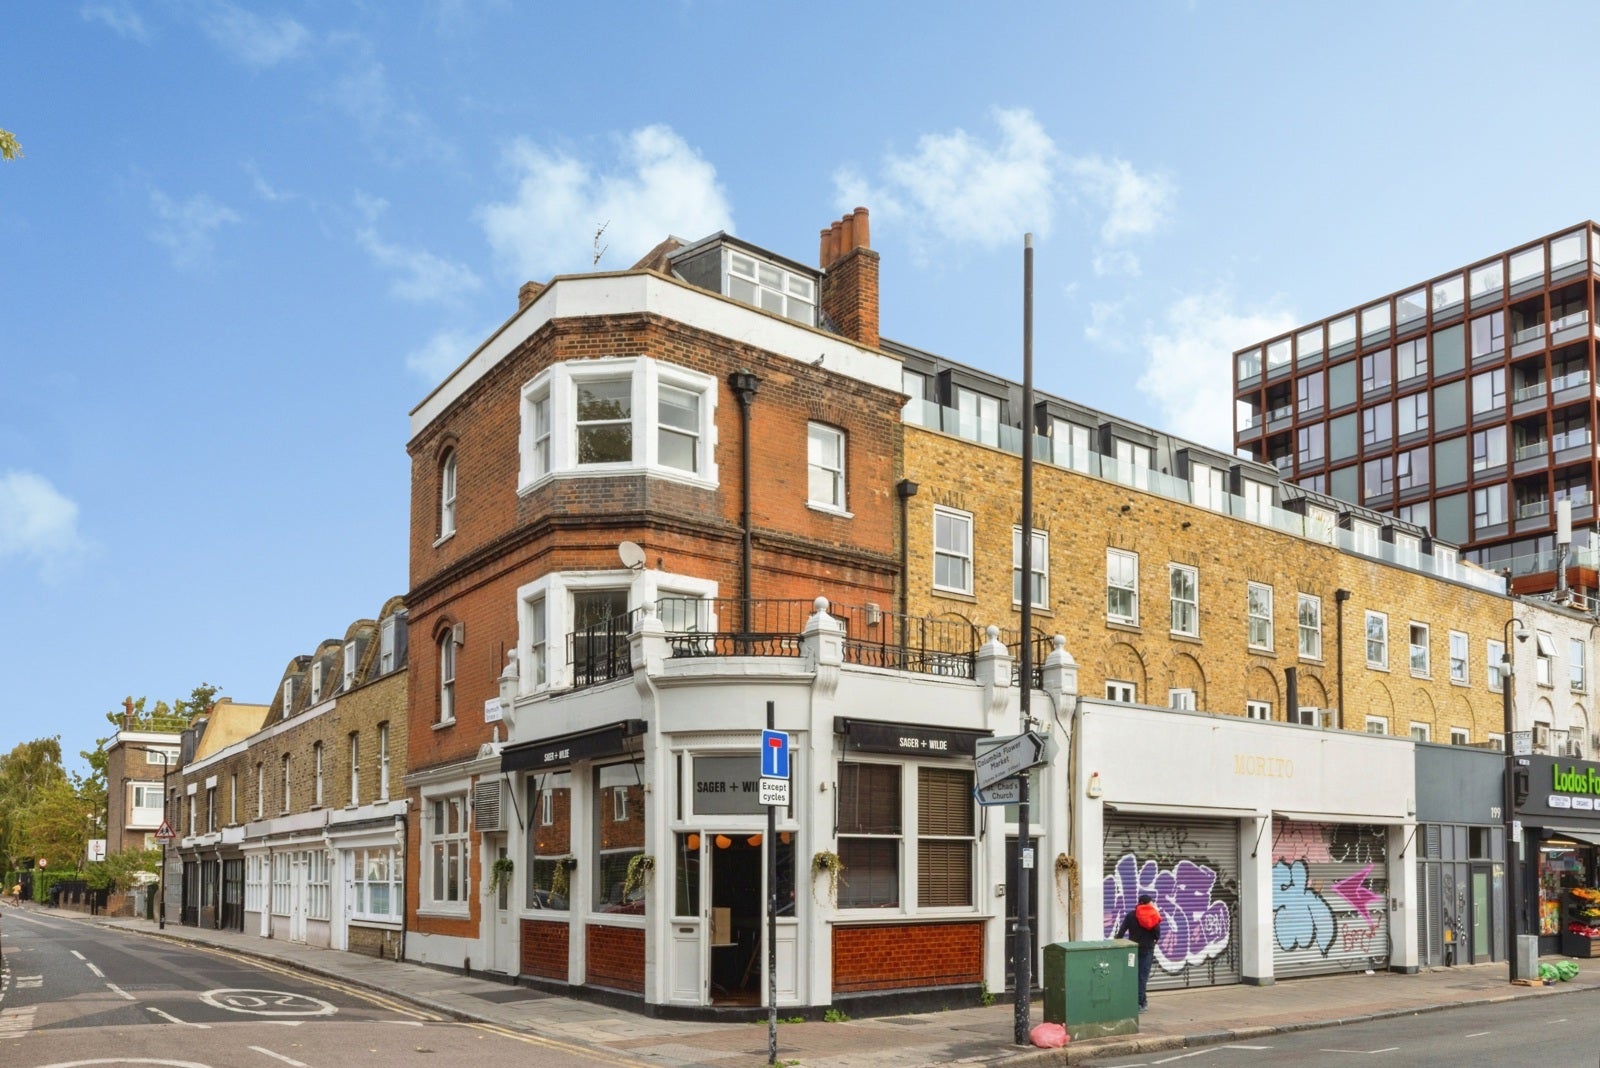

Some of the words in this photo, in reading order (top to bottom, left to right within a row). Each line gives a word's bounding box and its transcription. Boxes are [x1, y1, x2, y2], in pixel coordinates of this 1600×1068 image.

[899, 737, 919, 748] SAGER
[920, 739, 928, 748] +
[929, 739, 947, 750] WILDE
[977, 752, 1002, 768] Columbia
[1003, 741, 1021, 755] Flower
[990, 756, 1010, 770] Market
[1233, 754, 1294, 778] MORITO
[1554, 763, 1587, 793] Lodos
[697, 781, 726, 793] SAGER
[729, 782, 739, 792] +
[763, 782, 787, 792] Except
[997, 782, 1018, 791] Chad's
[763, 793, 786, 801] cycles
[992, 791, 1014, 800] Church
[1490, 807, 1502, 819] 199
